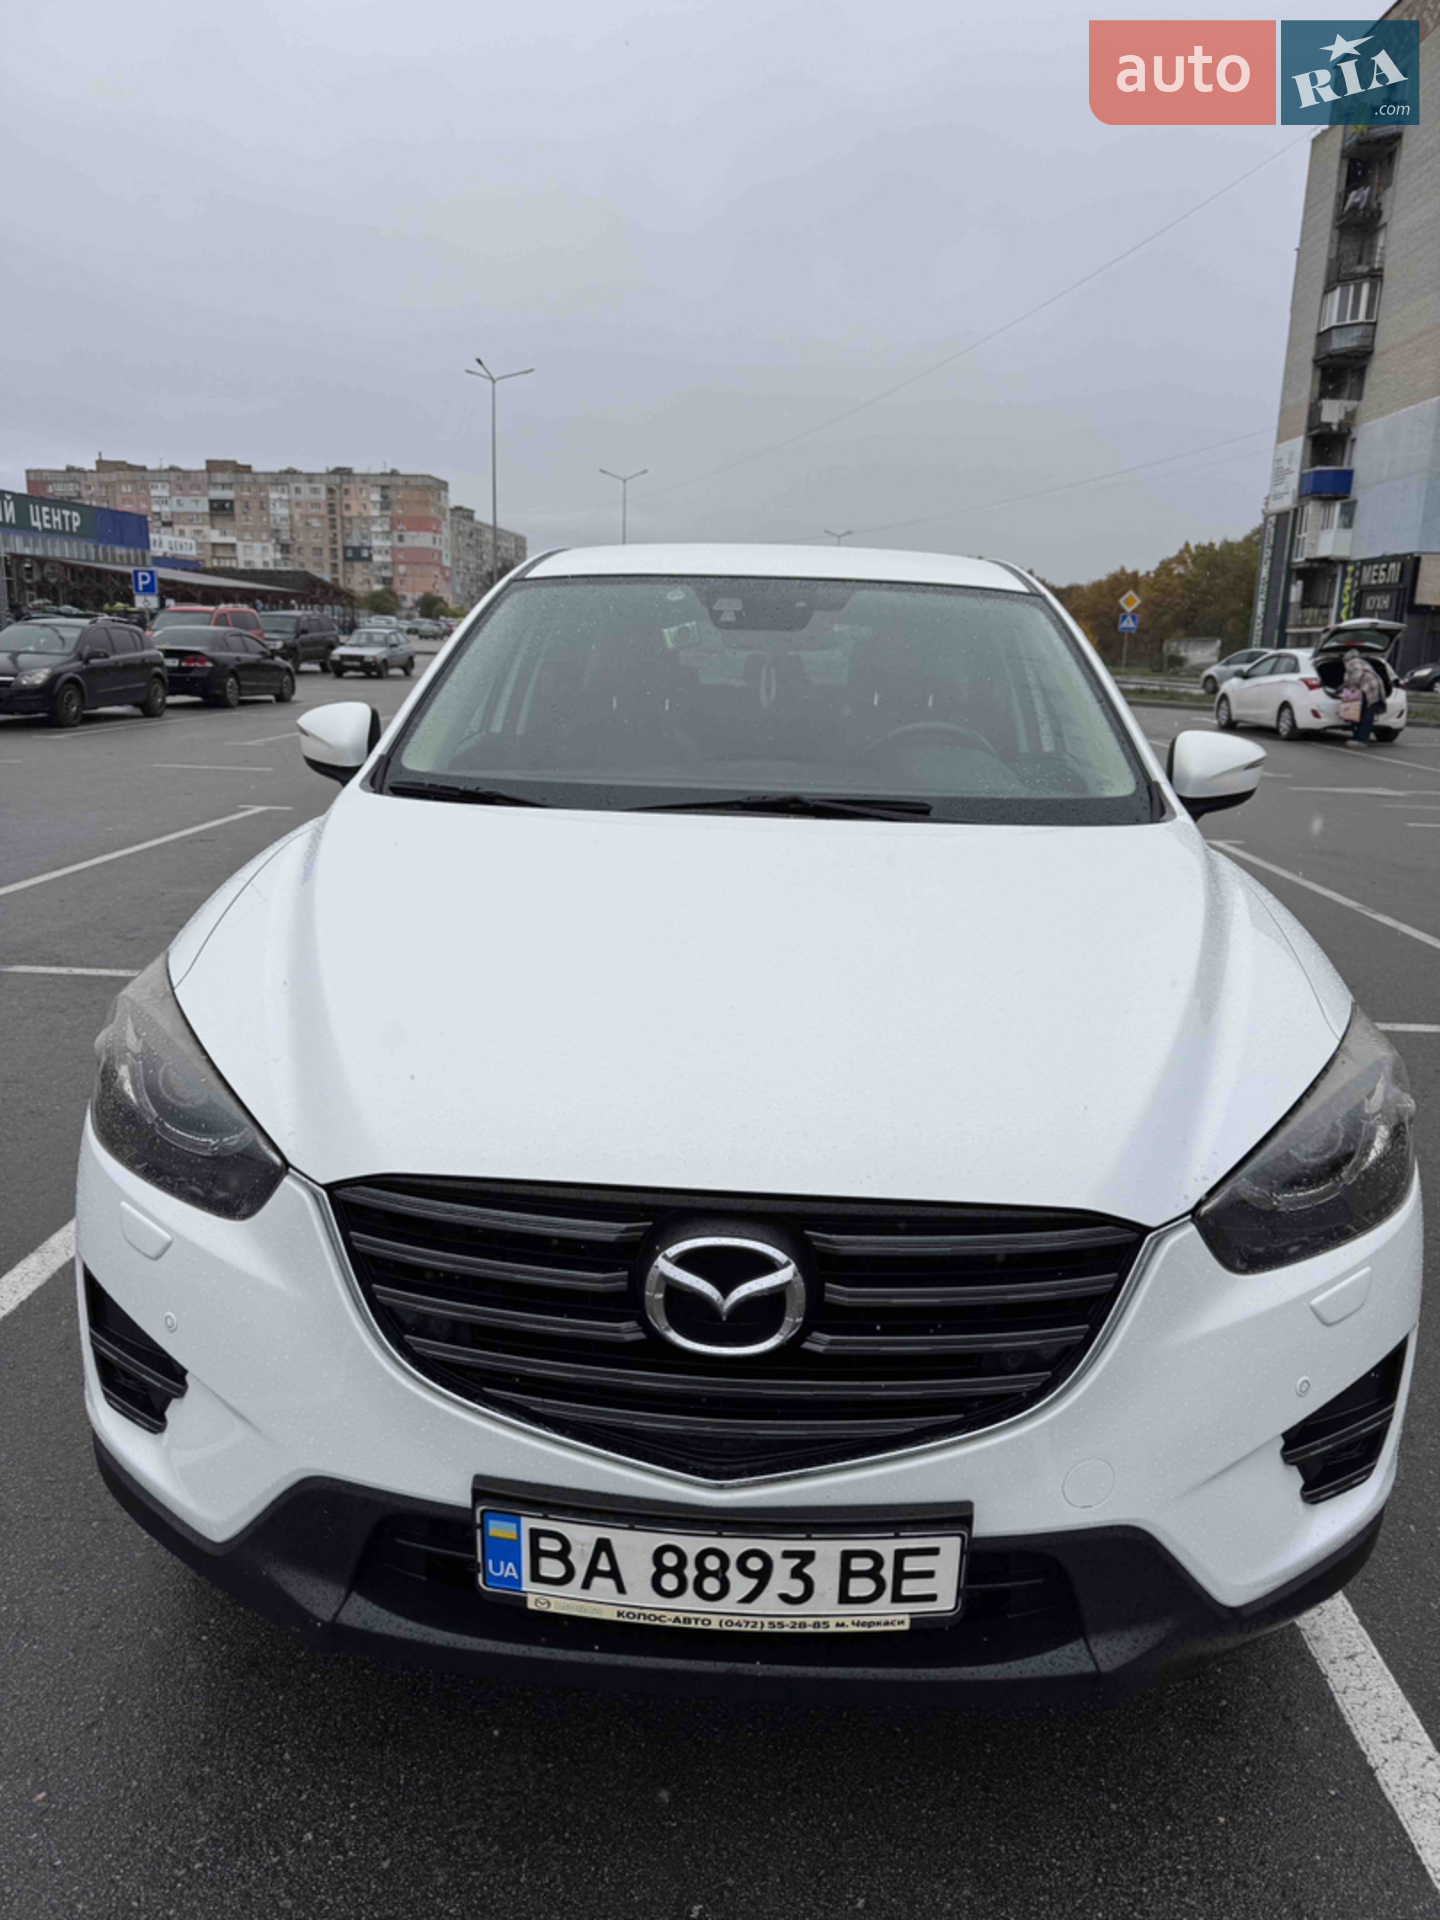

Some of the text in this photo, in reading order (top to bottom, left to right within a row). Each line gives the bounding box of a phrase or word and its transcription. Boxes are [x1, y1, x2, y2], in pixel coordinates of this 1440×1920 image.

[29, 503, 81, 533] ЦЕНТР
[1360, 562, 1402, 585] МЕБЛІ
[487, 1558, 520, 1581] UA
[528, 1526, 942, 1606] BA 8893 BE
[718, 1617, 765, 1631] (0472)
[767, 1619, 830, 1630] 55-28-85
[851, 1618, 906, 1629] Черкаси
